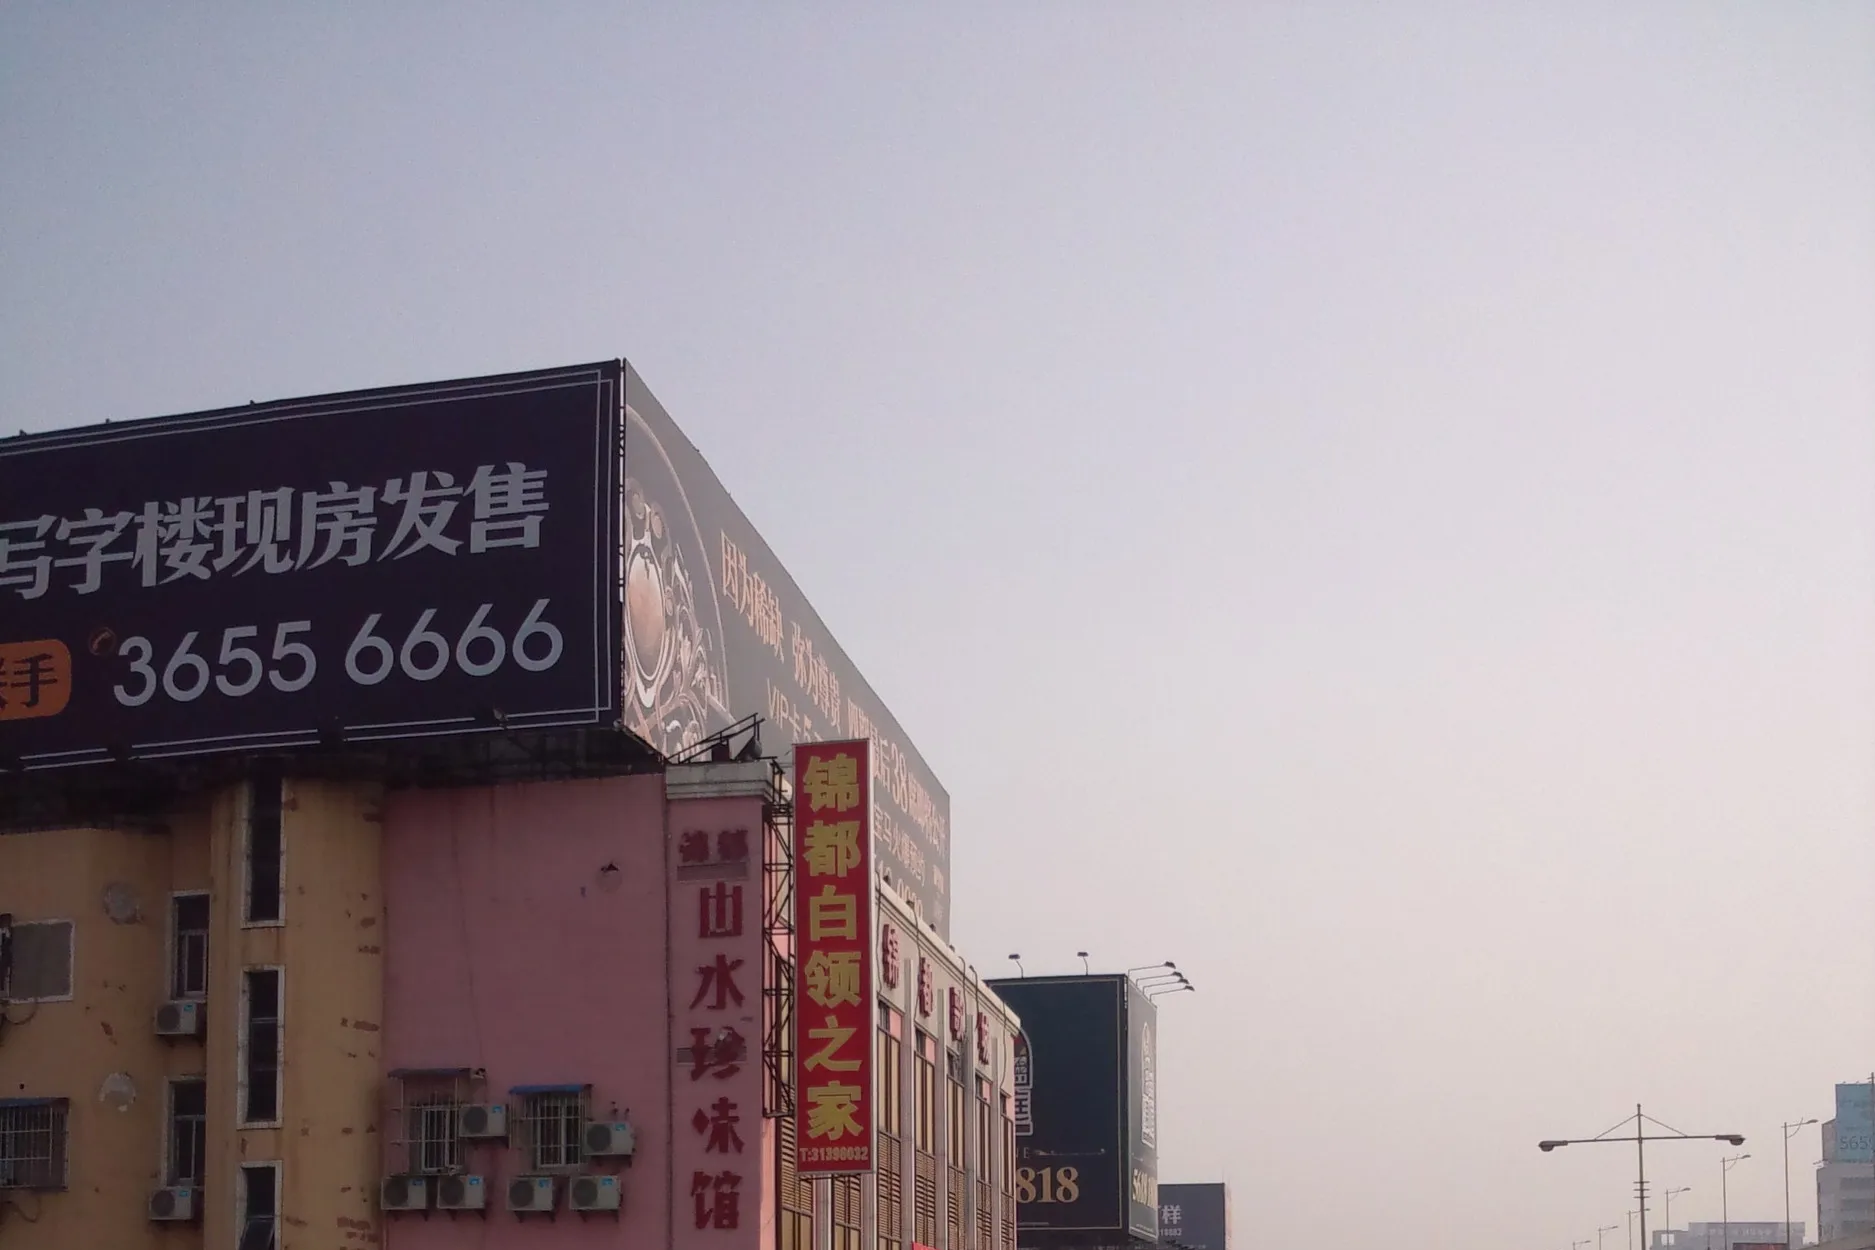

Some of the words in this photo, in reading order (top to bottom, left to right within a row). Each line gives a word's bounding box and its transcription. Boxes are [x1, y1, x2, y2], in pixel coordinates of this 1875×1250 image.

[0, 462, 550, 600] 写字楼现房发售
[0, 653, 58, 710] 手
[113, 620, 317, 707] 3655
[345, 598, 564, 686] 6666
[802, 752, 864, 1141] 锦都白领之家
[689, 881, 745, 1230] 山水珍味馆
